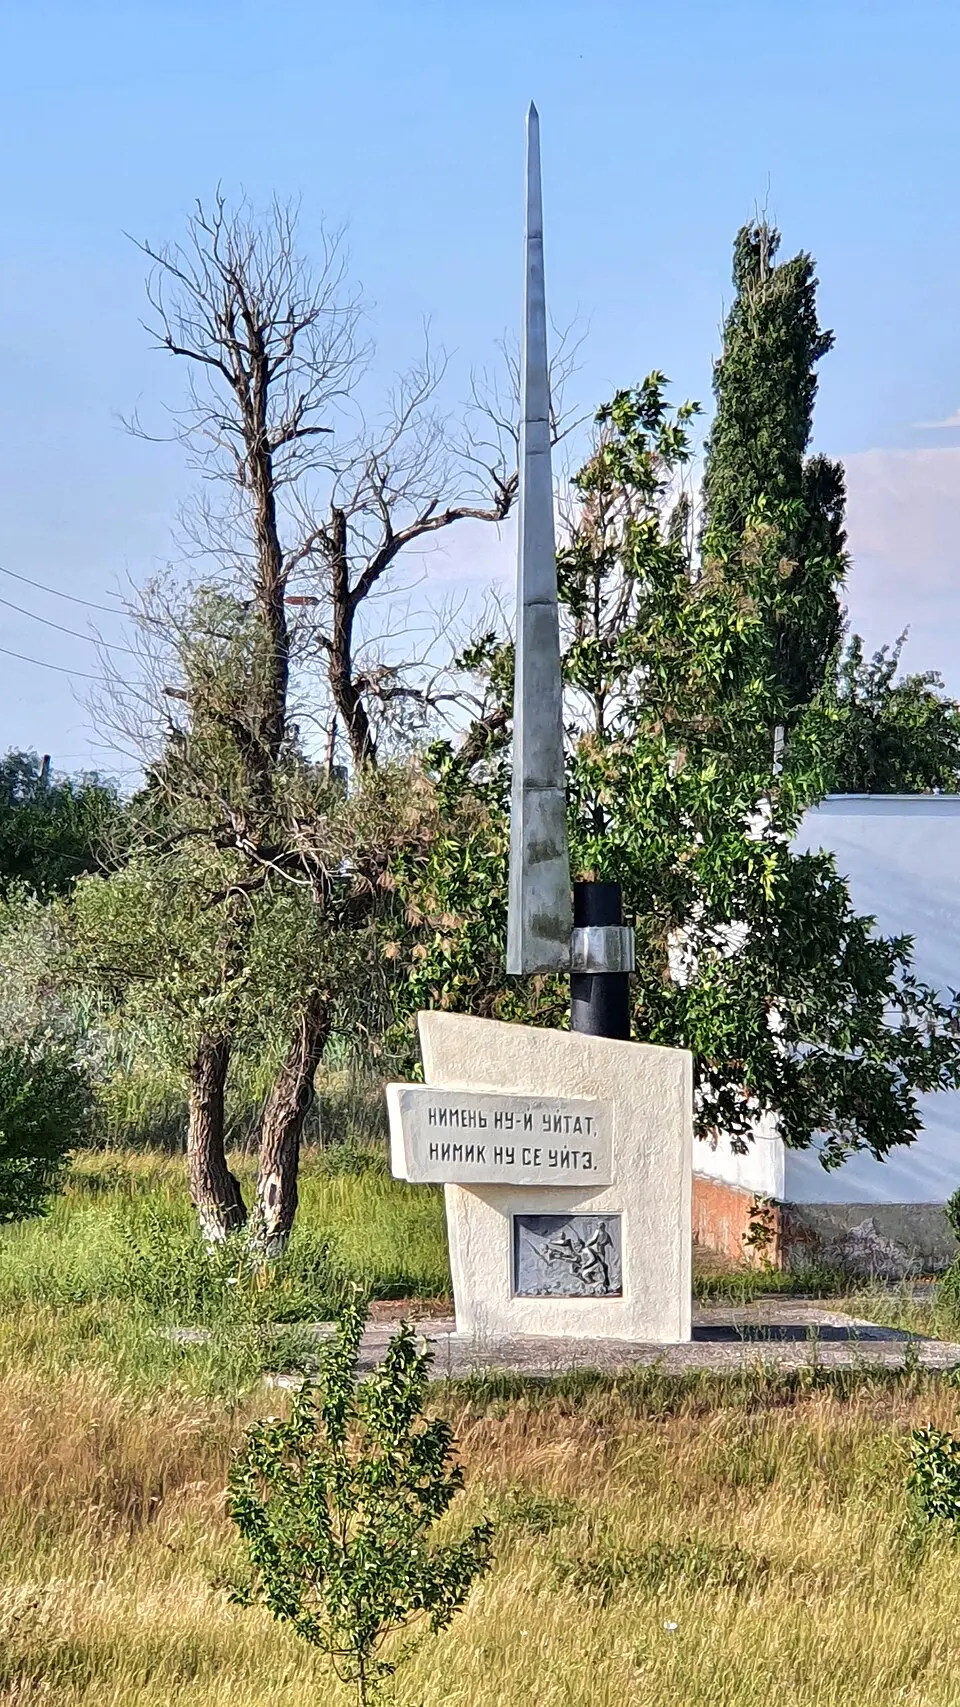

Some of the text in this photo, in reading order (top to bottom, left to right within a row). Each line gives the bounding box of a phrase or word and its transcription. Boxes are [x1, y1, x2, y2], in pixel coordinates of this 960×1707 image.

[428, 1107, 488, 1129] НИМЕНЬ
[542, 1109, 598, 1137] УЙТАТ,
[429, 1142, 487, 1164] НИМИК
[494, 1145, 516, 1165] НУ
[522, 1148, 543, 1167] СЕ
